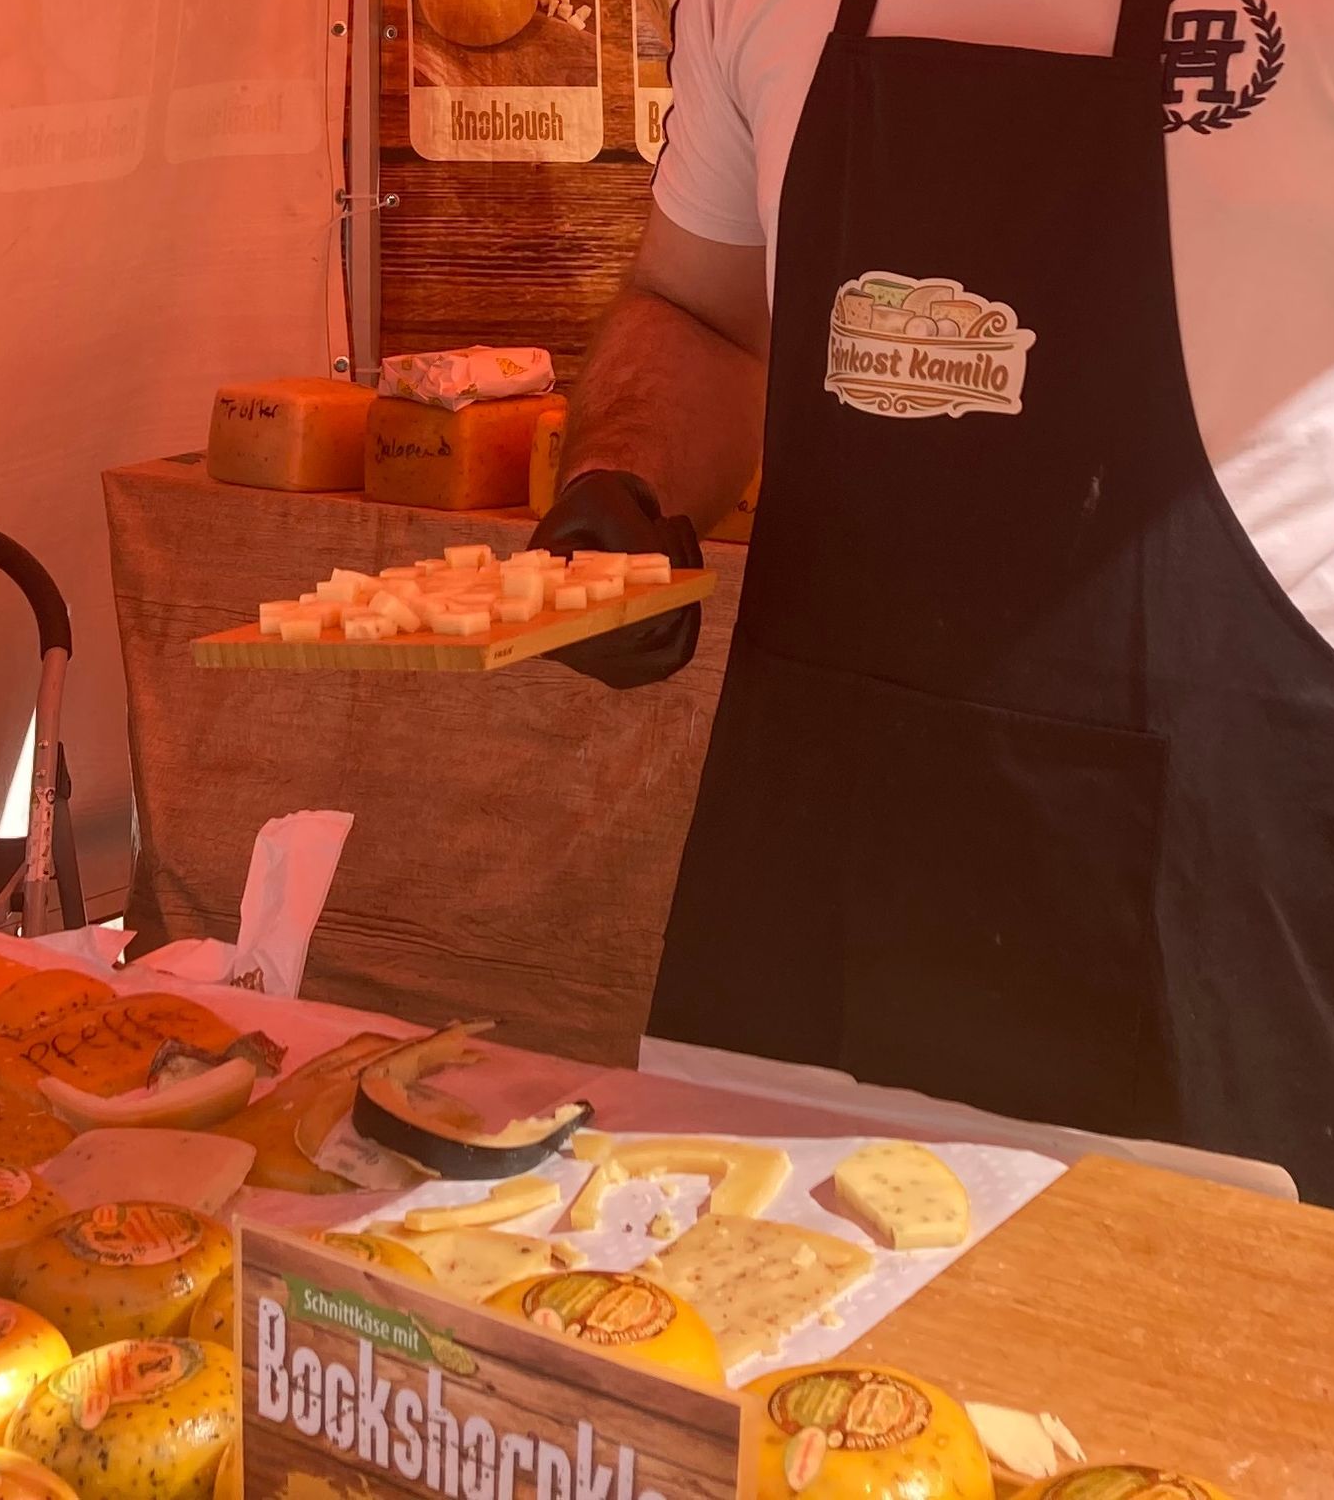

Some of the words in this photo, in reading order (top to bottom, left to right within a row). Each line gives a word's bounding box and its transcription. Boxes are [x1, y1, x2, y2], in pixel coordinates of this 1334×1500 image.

[451, 100, 564, 142] Knoblauch
[908, 348, 1009, 392] Kamilo
[303, 1288, 389, 1340] Schnittkäse
[393, 1324, 420, 1352] mit
[257, 1297, 667, 1500] Bockshornk
